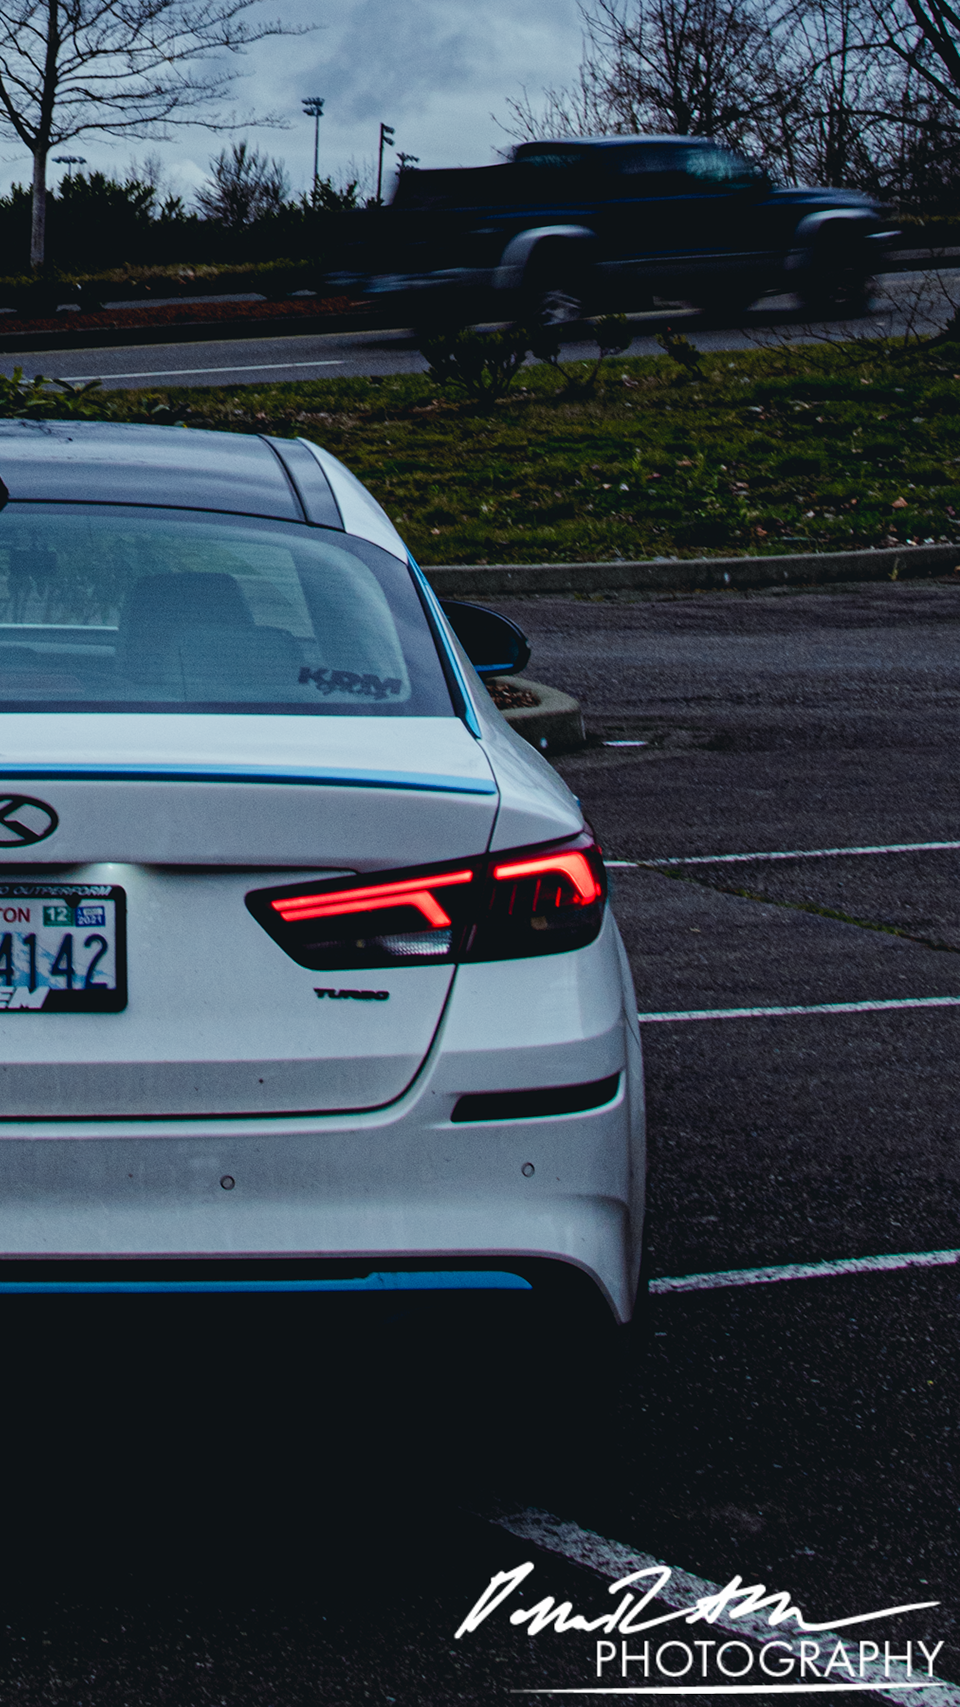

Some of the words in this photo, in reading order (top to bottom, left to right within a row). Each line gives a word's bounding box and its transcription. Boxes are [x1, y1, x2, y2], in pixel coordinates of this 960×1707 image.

[13, 885, 113, 896] OUTPERFORM
[46, 906, 68, 922] 12
[313, 987, 390, 1002] TURBO
